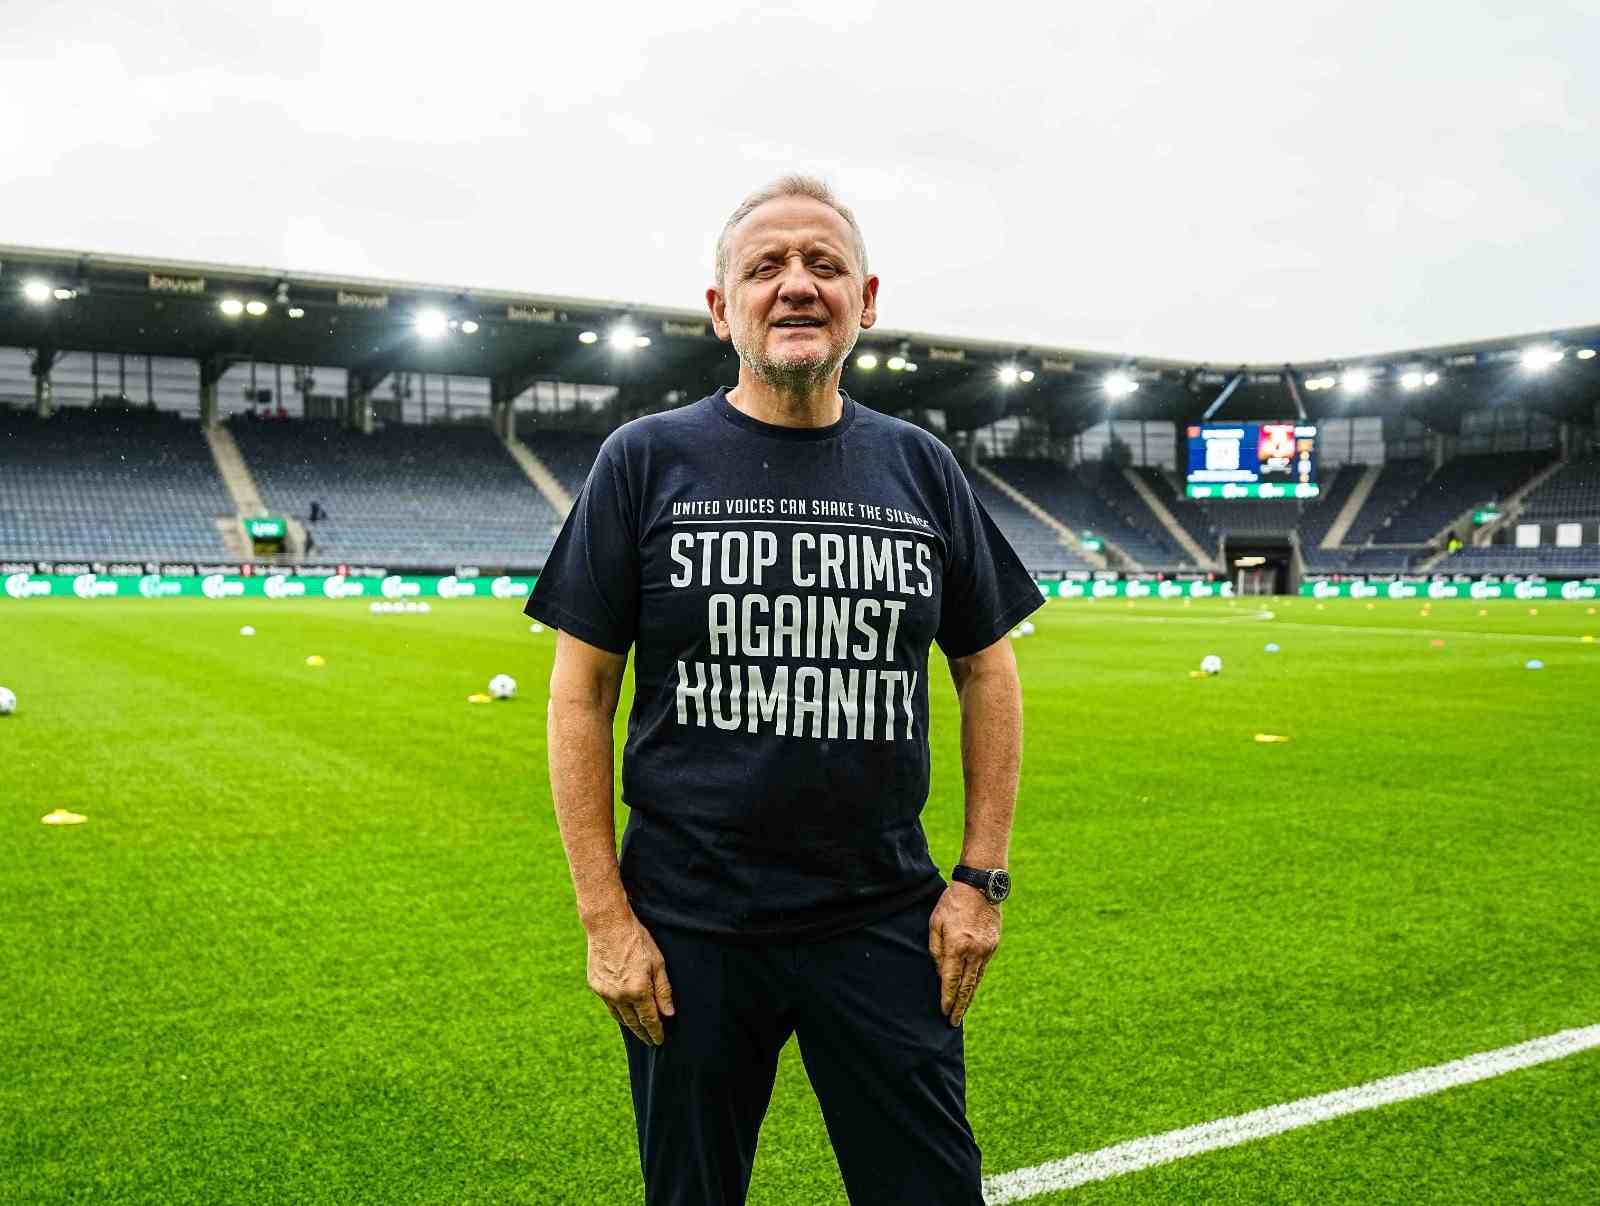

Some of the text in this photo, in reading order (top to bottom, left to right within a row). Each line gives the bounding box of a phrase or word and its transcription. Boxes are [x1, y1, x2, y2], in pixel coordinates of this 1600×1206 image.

[673, 499, 930, 528] UNITED VOICES CAN SHAKE THE SILENCE
[670, 531, 932, 597] STOP CRIMES
[708, 594, 906, 661] AGAINST
[676, 660, 918, 740] HUMANITY
